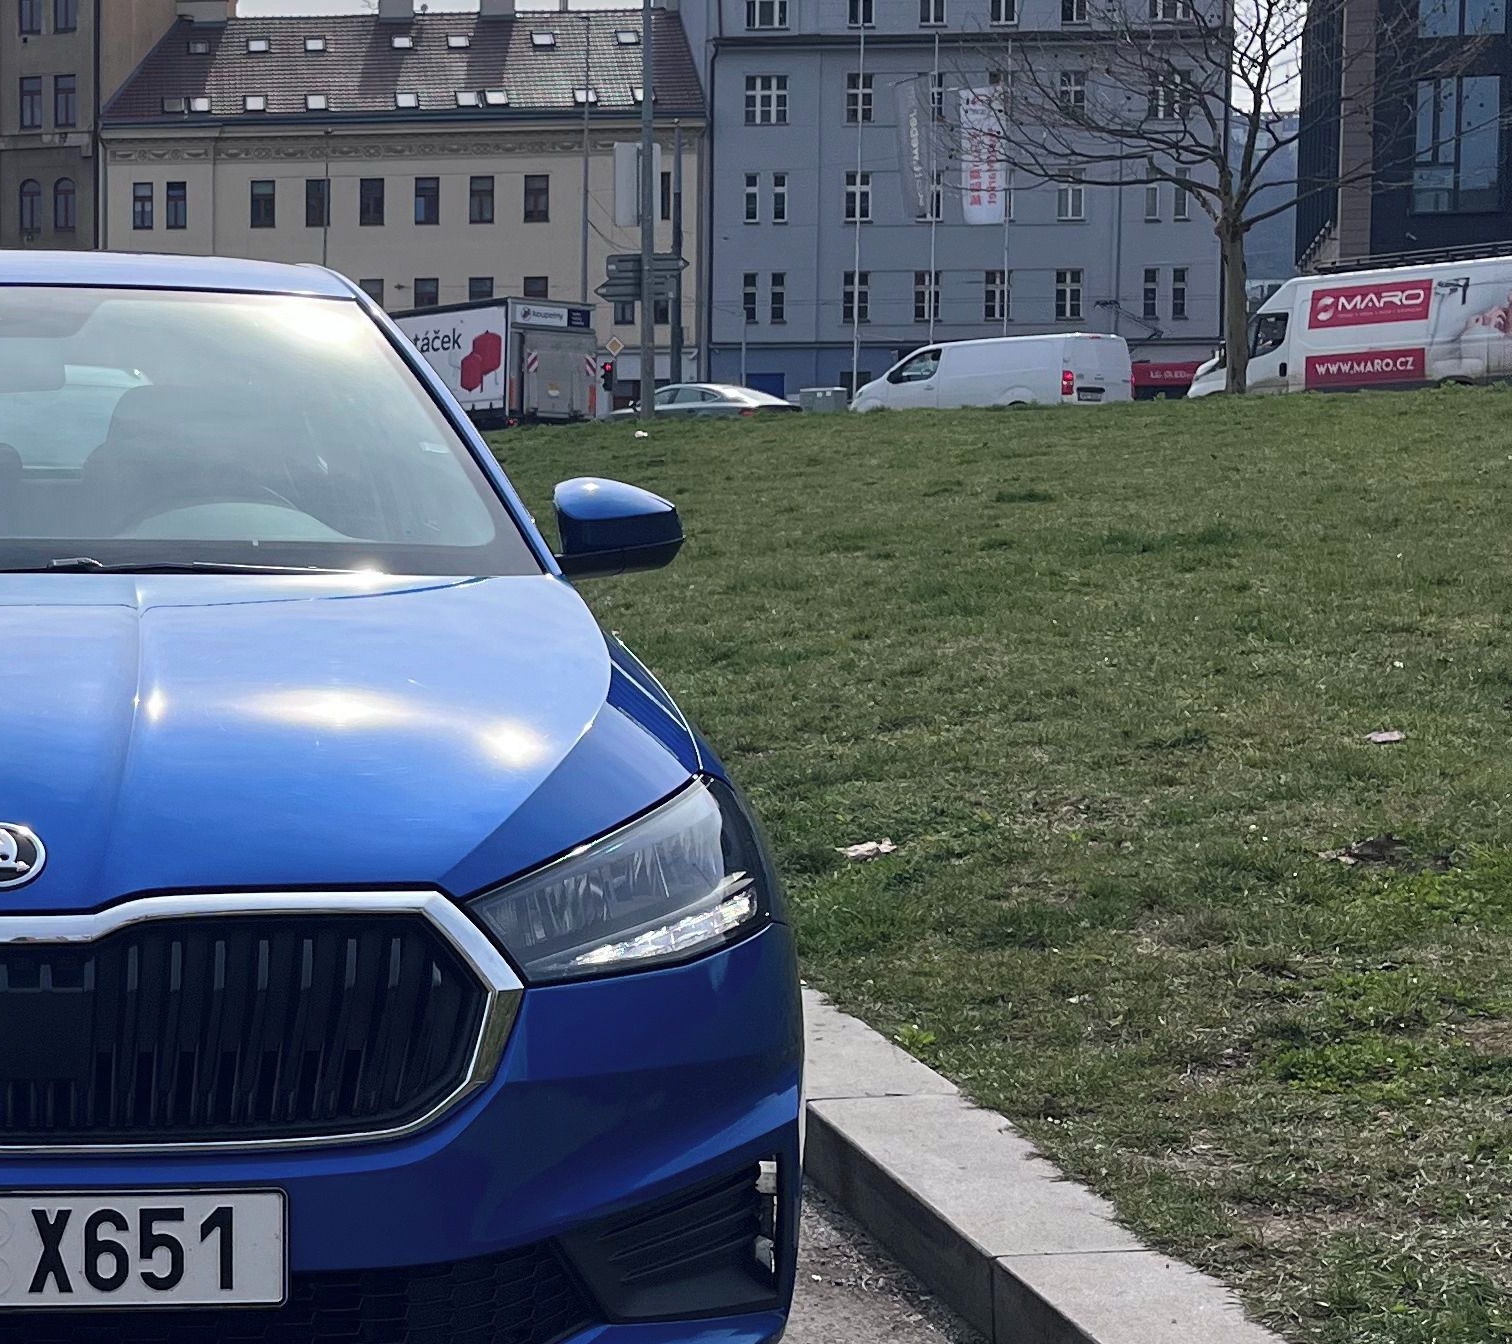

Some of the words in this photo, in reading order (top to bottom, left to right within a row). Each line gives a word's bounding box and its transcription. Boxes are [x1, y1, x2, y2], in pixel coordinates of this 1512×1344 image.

[1338, 288, 1425, 312] MARO
[1315, 356, 1414, 376] WWW.MARO.CZ
[28, 1205, 236, 1294] X651
